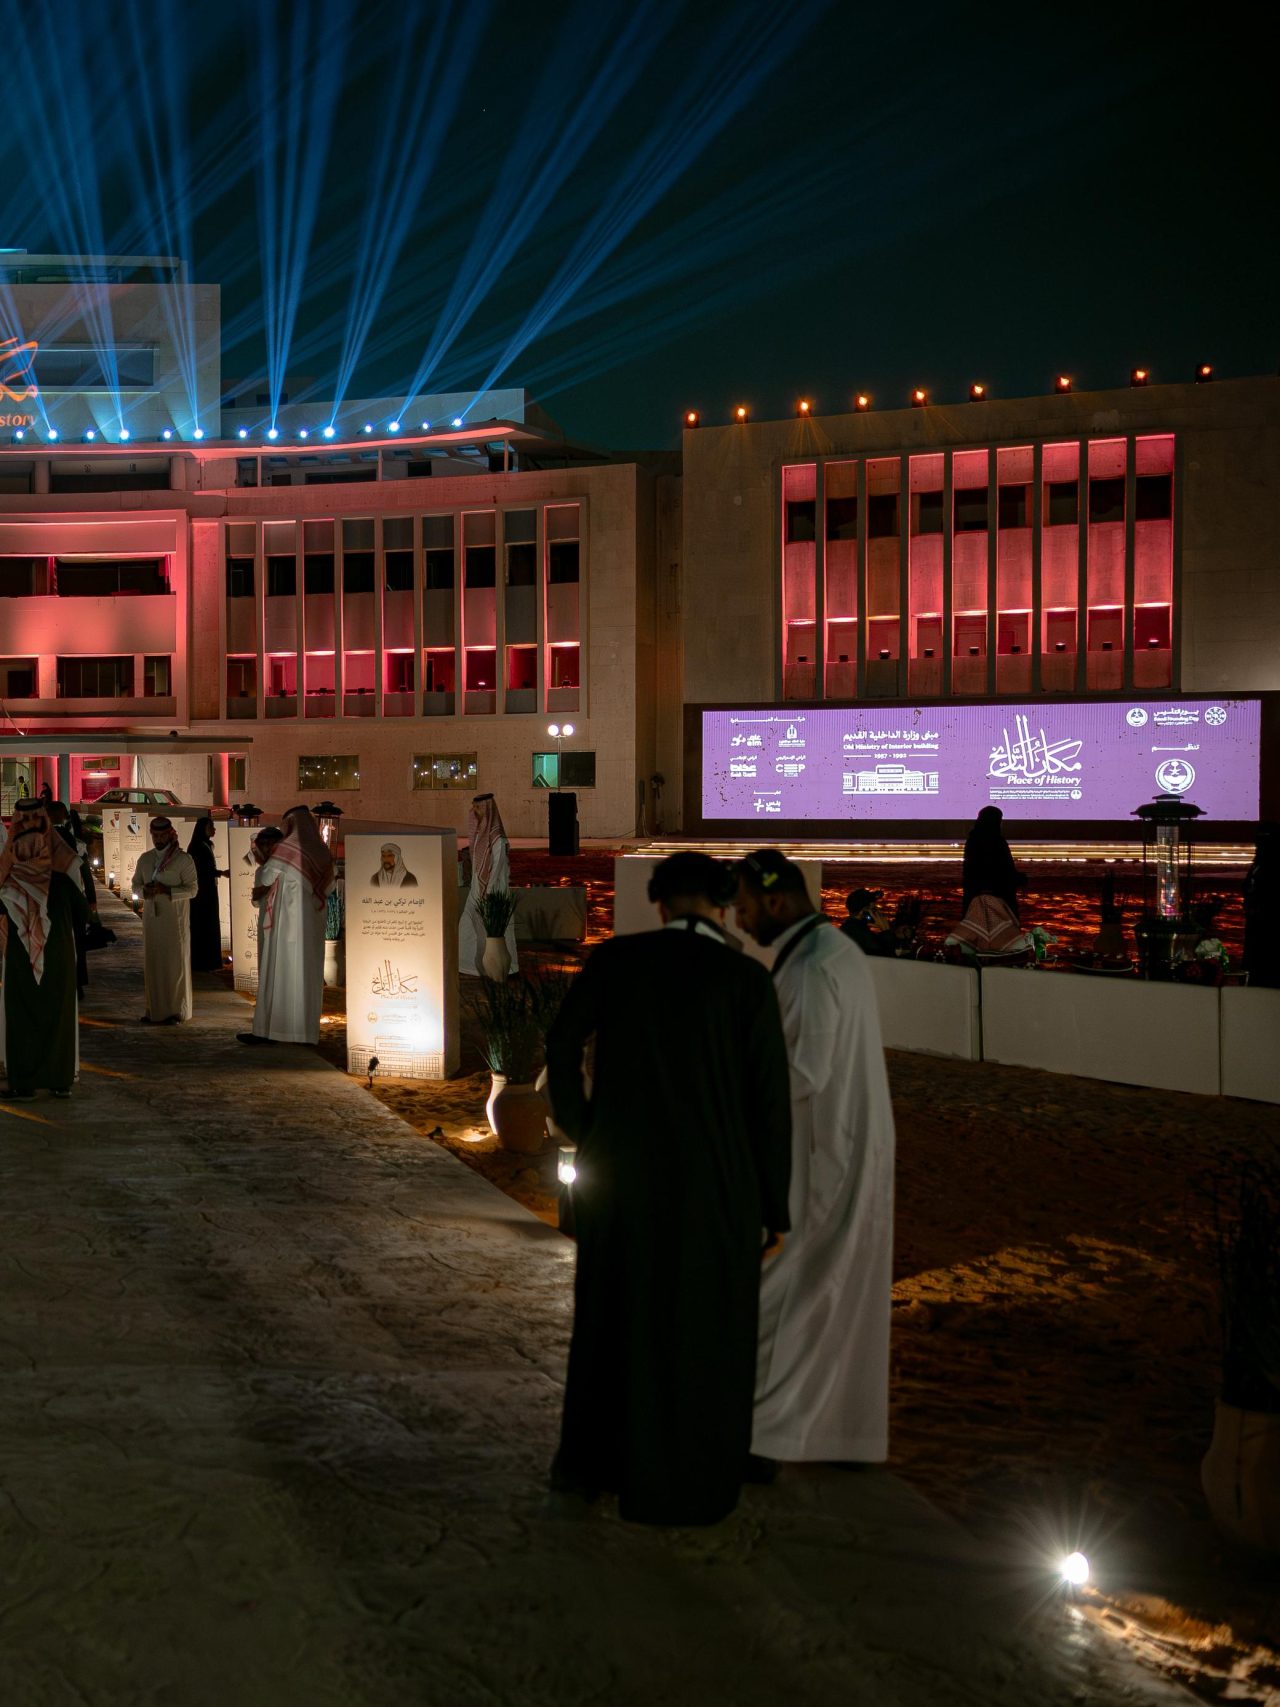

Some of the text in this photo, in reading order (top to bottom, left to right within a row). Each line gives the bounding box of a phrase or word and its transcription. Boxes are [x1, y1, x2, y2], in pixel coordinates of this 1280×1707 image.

[855, 743, 880, 751] Ministry
[1007, 775, 1082, 786] Place of History
